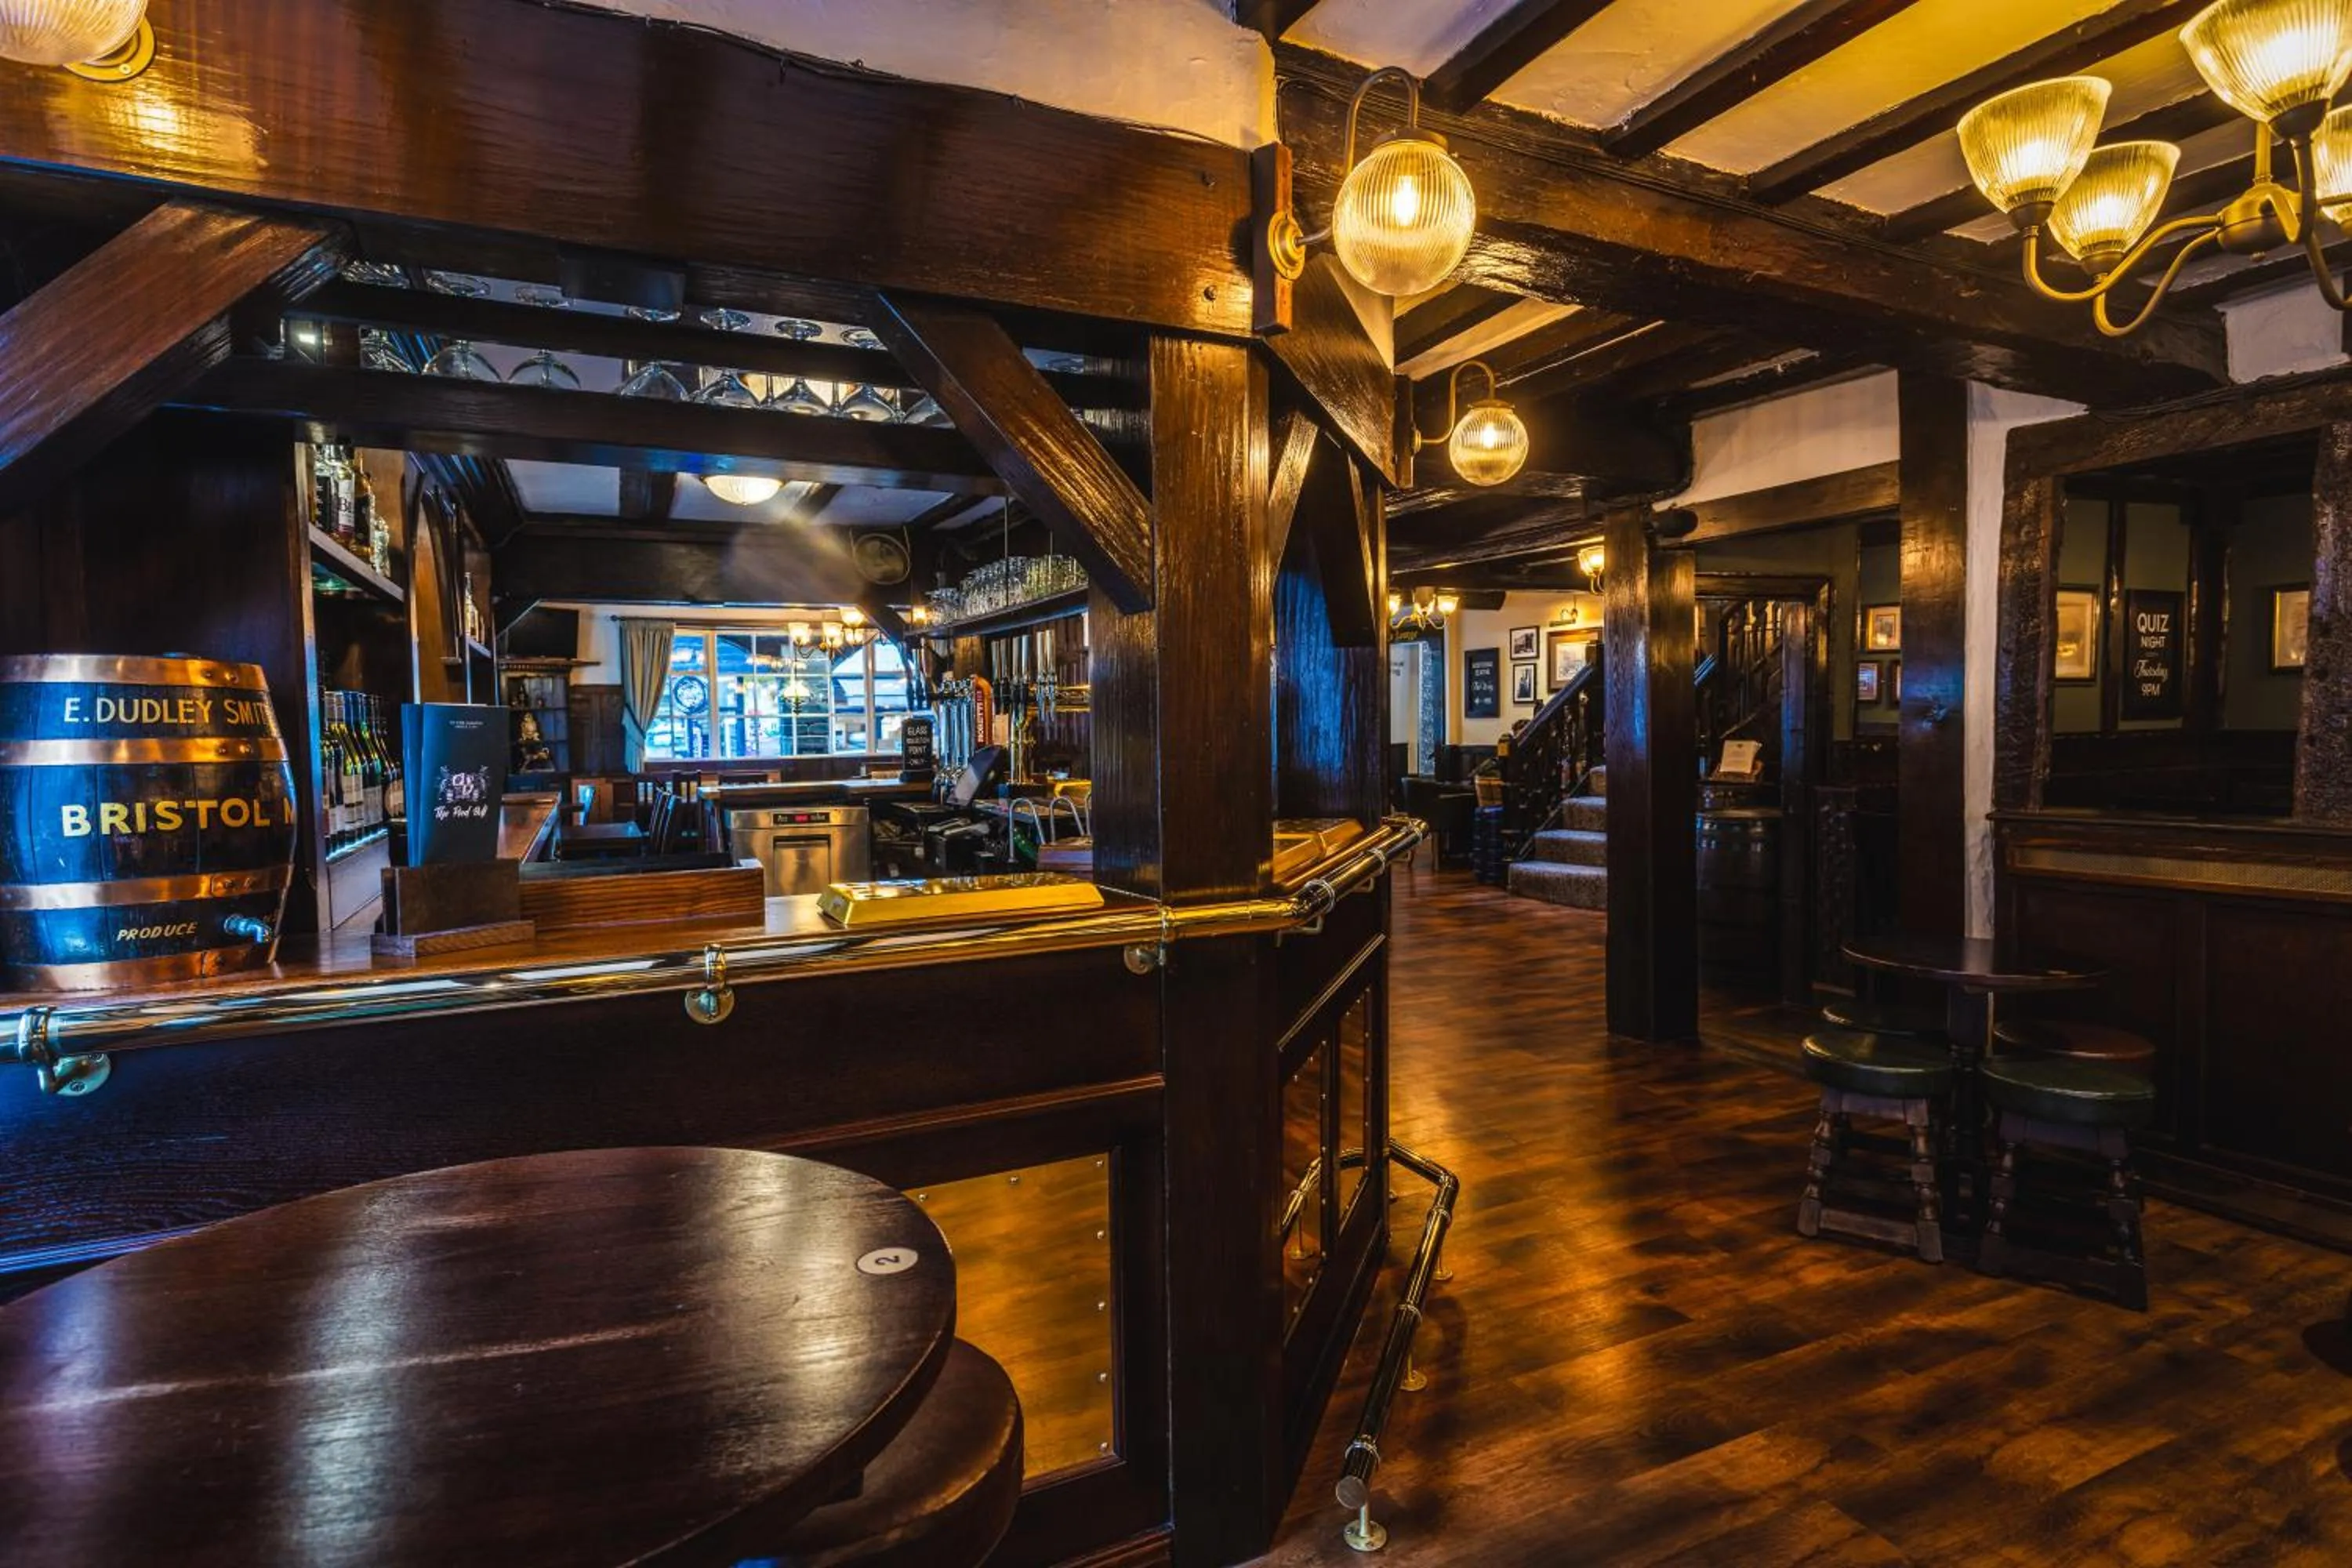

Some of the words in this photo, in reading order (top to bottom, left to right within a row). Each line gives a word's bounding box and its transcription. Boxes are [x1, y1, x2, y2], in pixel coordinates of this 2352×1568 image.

[2136, 612, 2169, 633] QUIZ
[2140, 635, 2165, 648] NIGHT
[64, 697, 90, 723] E.
[96, 697, 214, 724] DUDLEY
[223, 698, 269, 725] SMIT
[61, 797, 270, 837] BRISTOL
[117, 921, 198, 941] PRODUCE
[874, 1255, 900, 1266] 2
